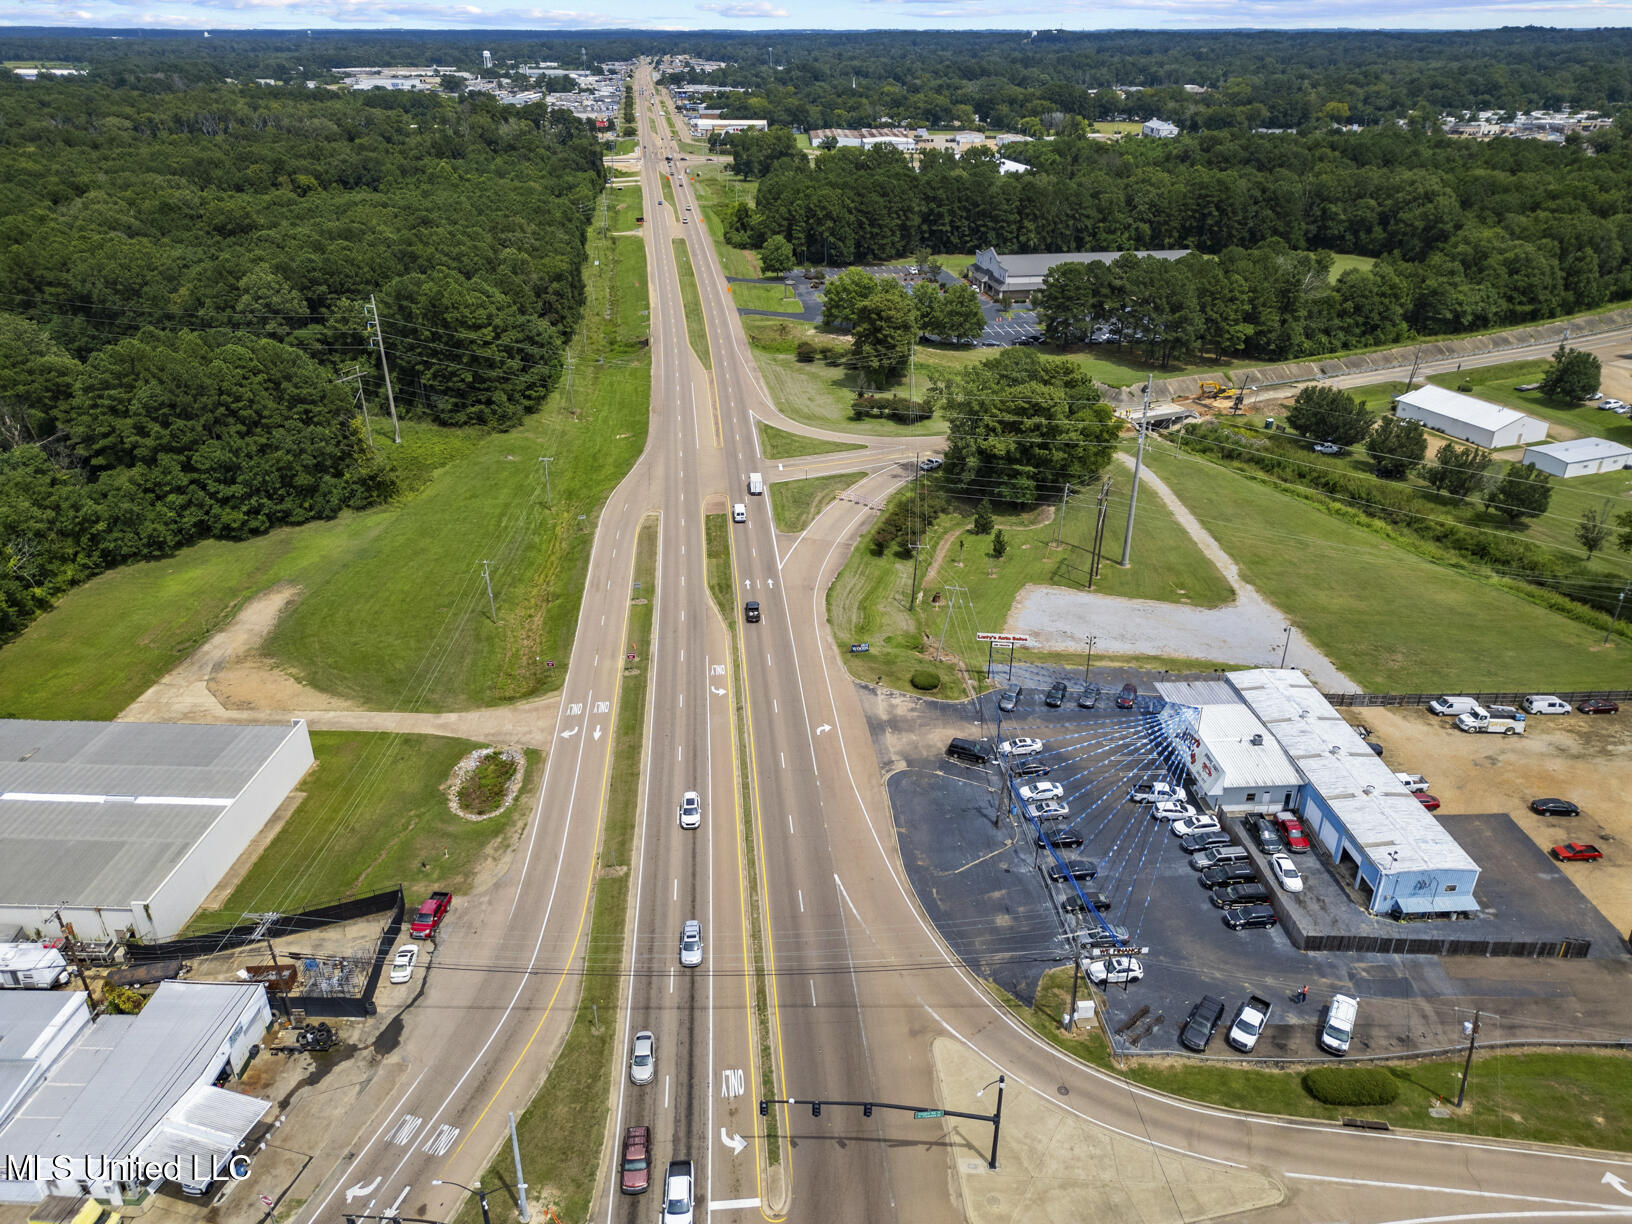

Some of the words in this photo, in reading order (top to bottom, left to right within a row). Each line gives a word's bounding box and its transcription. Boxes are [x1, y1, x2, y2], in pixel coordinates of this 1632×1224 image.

[711, 665, 725, 676] ONLY
[566, 703, 583, 716] ONLY
[593, 701, 610, 713] ONLY
[1113, 947, 1142, 955] FINANCE
[722, 1069, 745, 1098] ONLY
[384, 1114, 423, 1146] ONLY
[421, 1123, 461, 1157] ONLY
